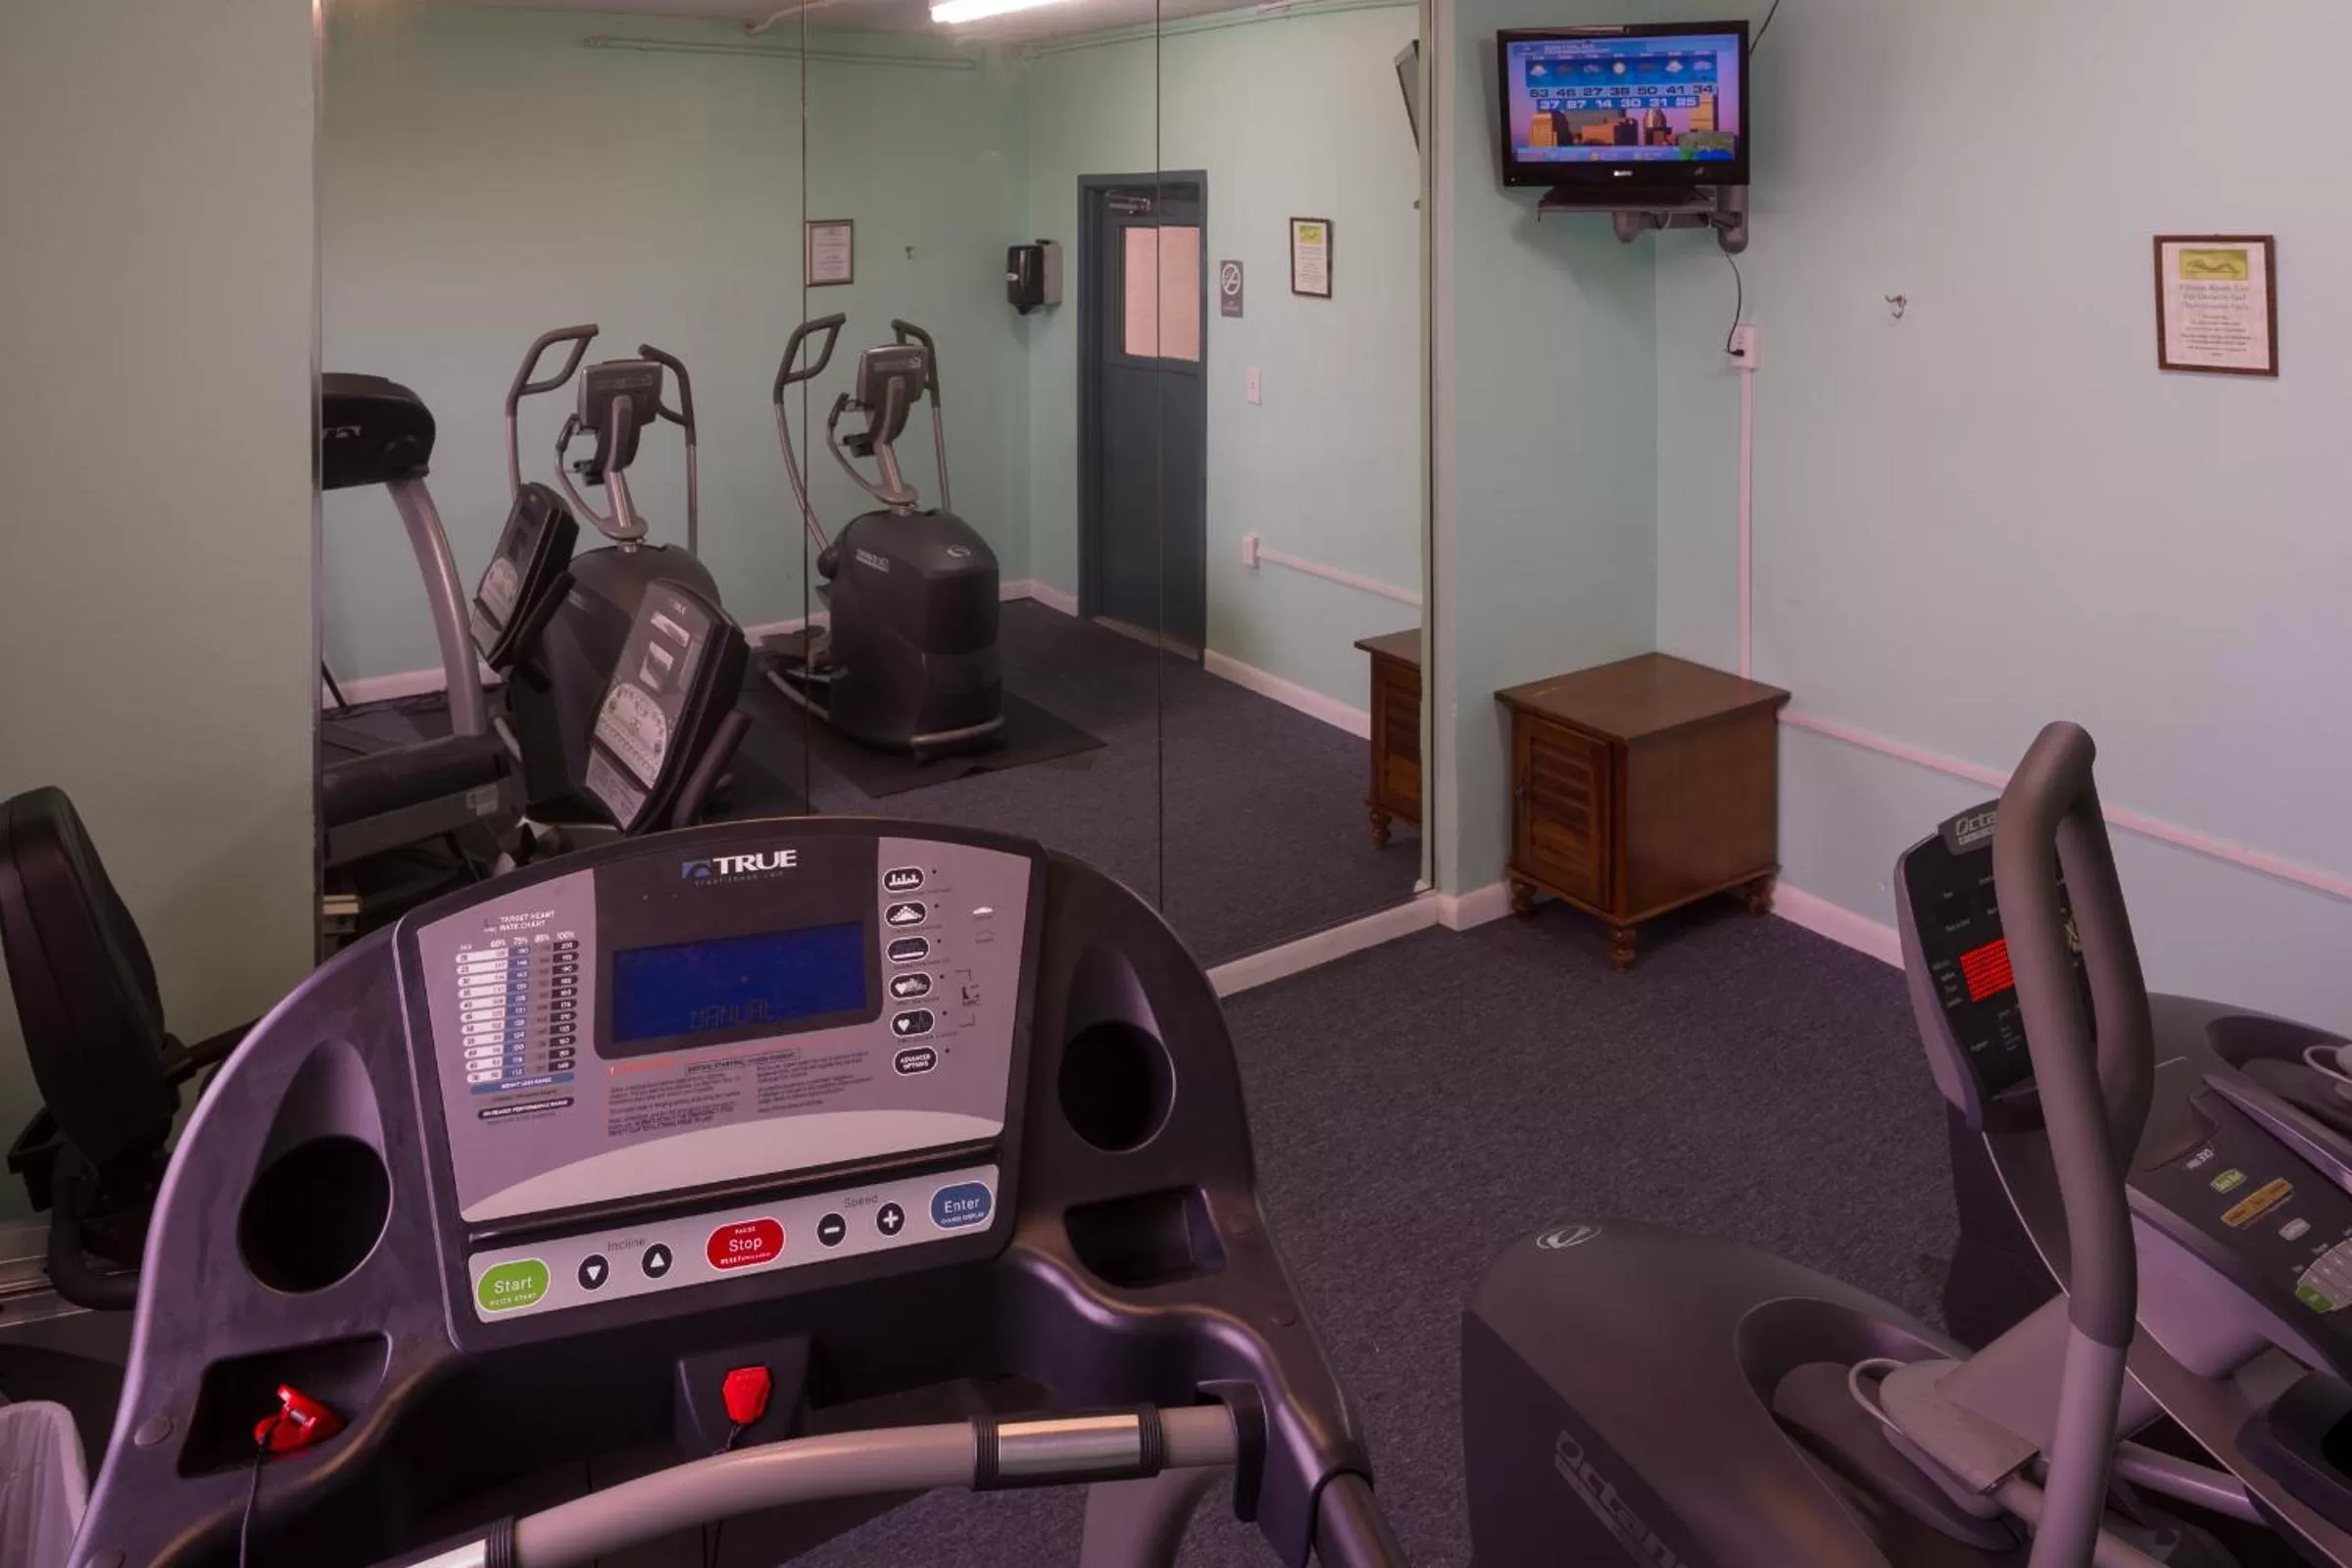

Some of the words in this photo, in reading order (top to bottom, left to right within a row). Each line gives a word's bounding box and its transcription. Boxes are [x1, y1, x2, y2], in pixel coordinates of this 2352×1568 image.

[1583, 87, 1603, 96] 27
[1637, 86, 1657, 95] 50
[1665, 85, 1686, 94] 41
[1692, 85, 1713, 94] 34
[1540, 100, 1560, 110] 37
[1595, 99, 1612, 109] 14
[1621, 98, 1642, 108] 30
[1956, 810, 1996, 836] Octa
[712, 849, 798, 875] TRUE
[500, 913, 529, 923] TARGET
[520, 920, 546, 929] CHART
[843, 1194, 879, 1209] Speed
[945, 1199, 979, 1213] Enter
[608, 1237, 646, 1252] Incline
[729, 1238, 762, 1252] Stop
[494, 1275, 533, 1294] Start
[1555, 1429, 1688, 1568] Octan
